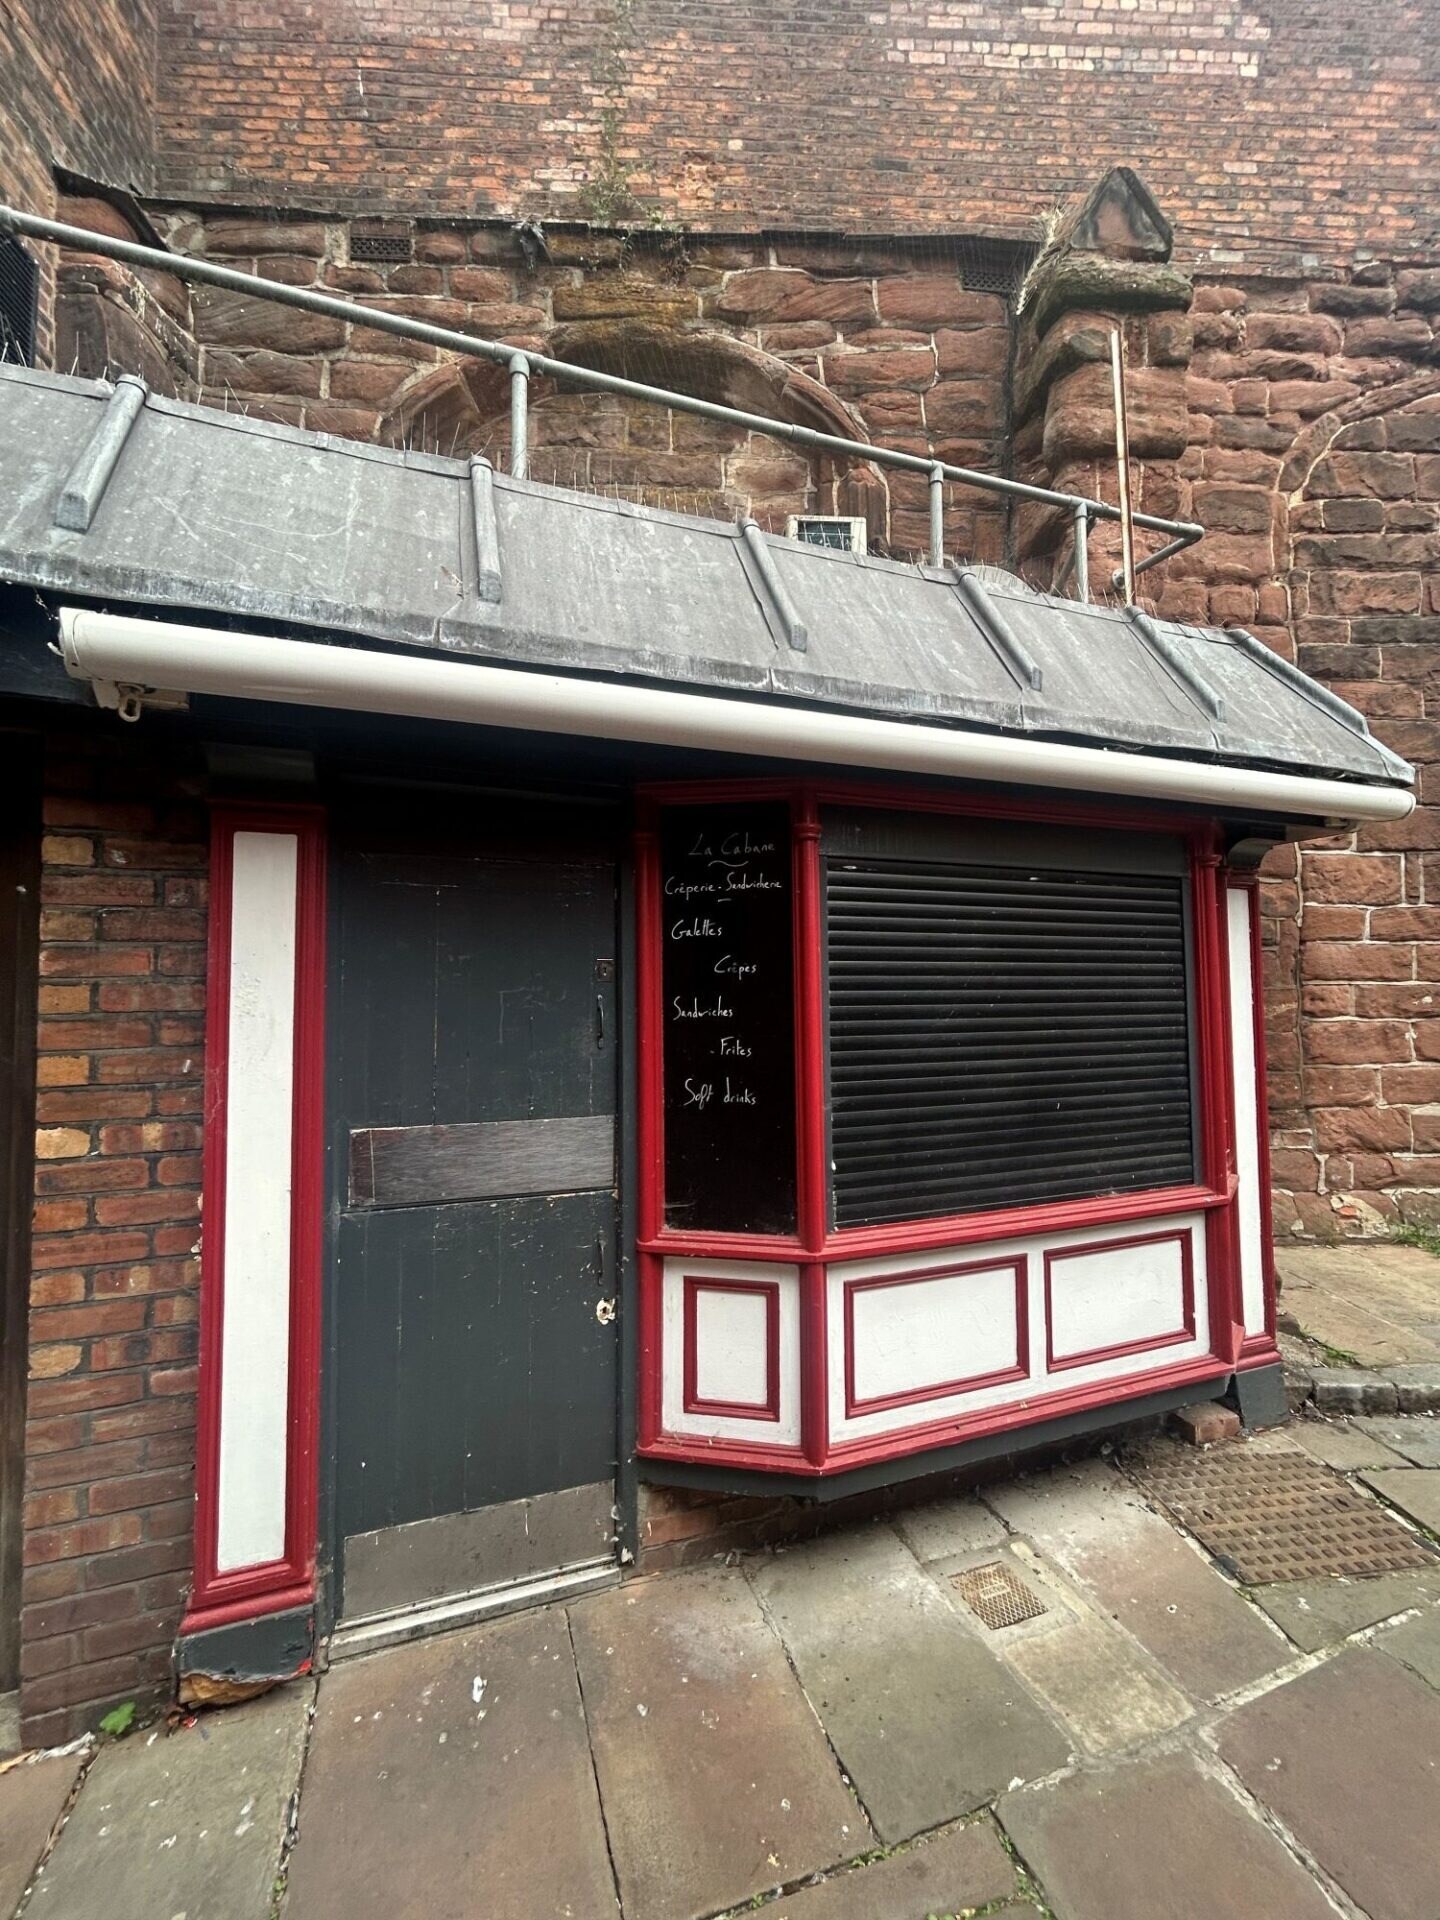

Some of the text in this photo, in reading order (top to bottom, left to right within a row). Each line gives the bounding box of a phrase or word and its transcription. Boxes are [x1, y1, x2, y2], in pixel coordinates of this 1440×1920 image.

[688, 832, 775, 856] La Cabane
[671, 917, 722, 940] Galettes
[672, 995, 734, 1021] Sandwiches
[720, 1036, 752, 1058] Frites
[683, 1076, 757, 1111] Soft drinks
